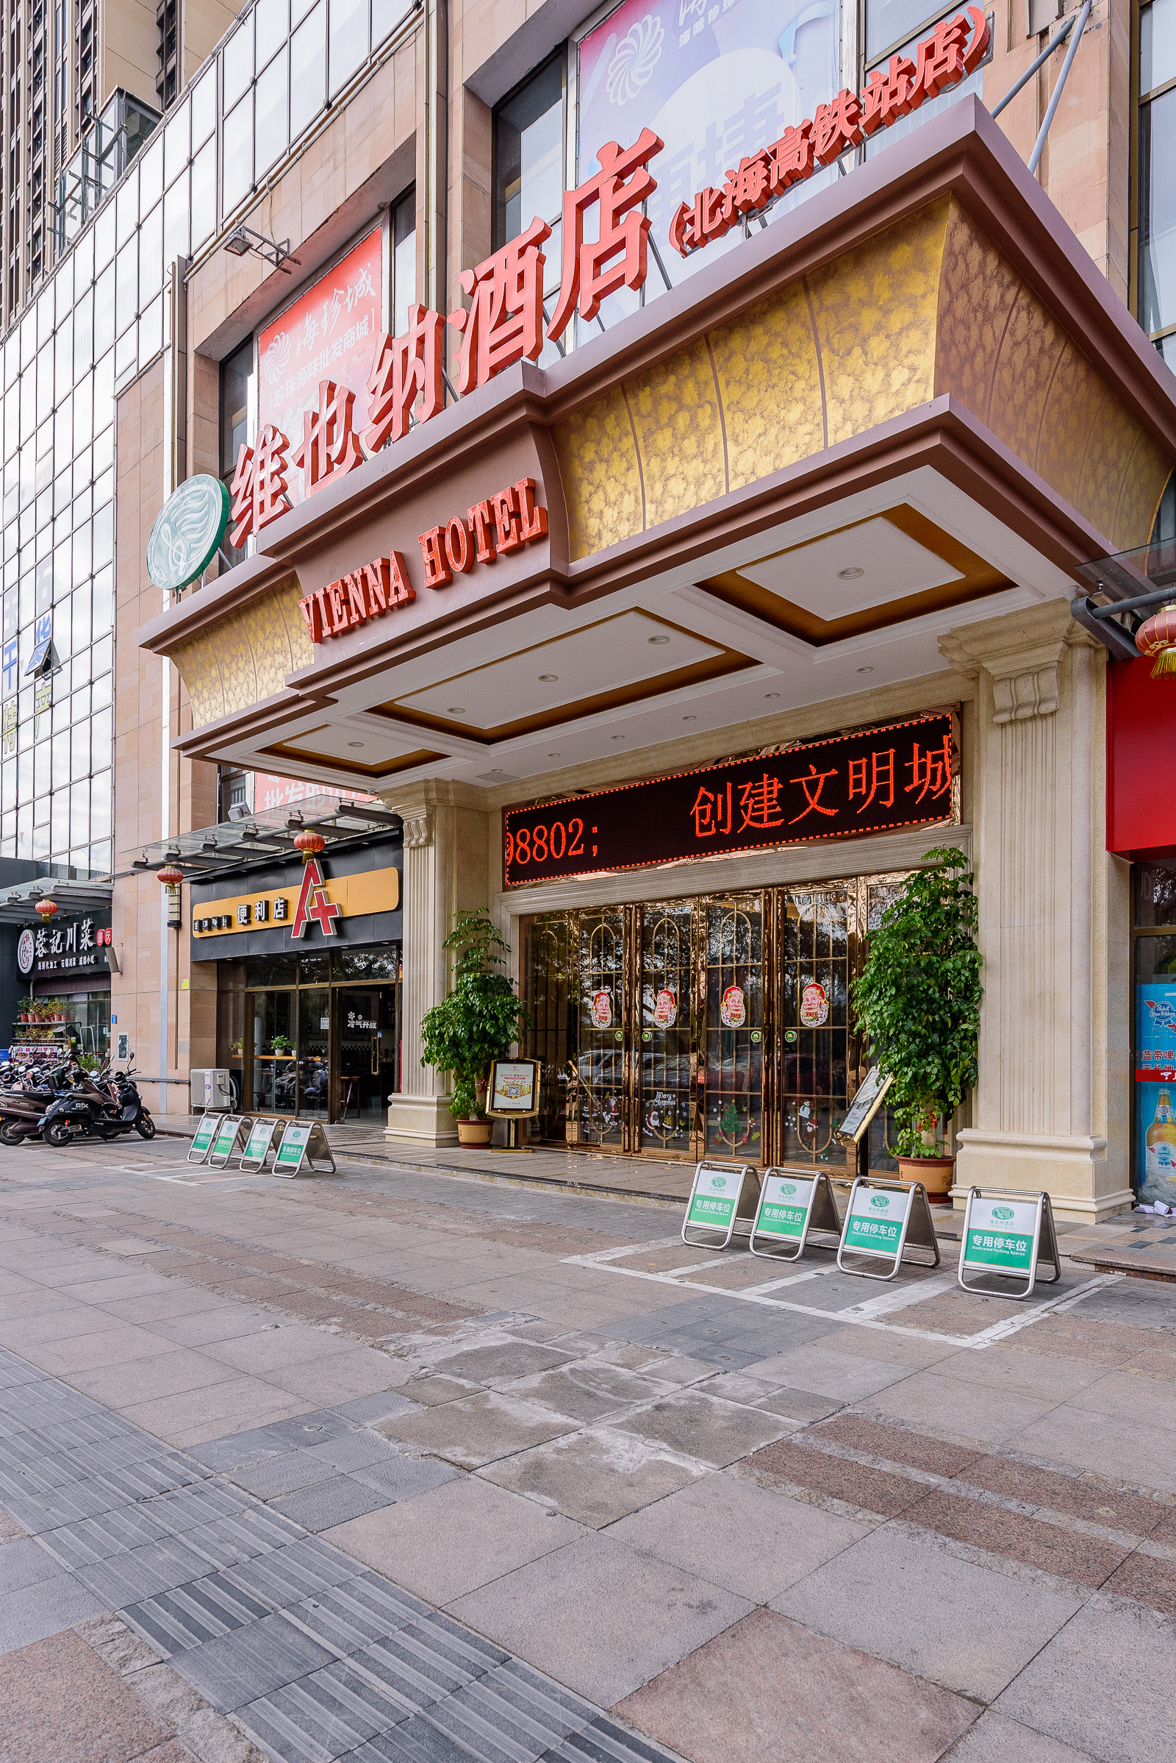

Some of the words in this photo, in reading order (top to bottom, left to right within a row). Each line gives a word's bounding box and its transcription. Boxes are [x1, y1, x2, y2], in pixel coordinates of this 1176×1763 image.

[669, 6, 991, 257] (北海高铁站店)
[230, 127, 665, 548] 维也纳酒店
[299, 551, 417, 644] VIENNA
[419, 477, 549, 588] HOTEL
[691, 735, 952, 838] 创建文明城
[237, 897, 287, 926] 便利店
[1142, 1050, 1176, 1060] 蓝带啤
[696, 1199, 731, 1213] 专用停车位
[764, 1207, 803, 1222] 专用停车位
[853, 1221, 898, 1237] 专用停车位
[972, 1235, 1027, 1252] 专用停车位
